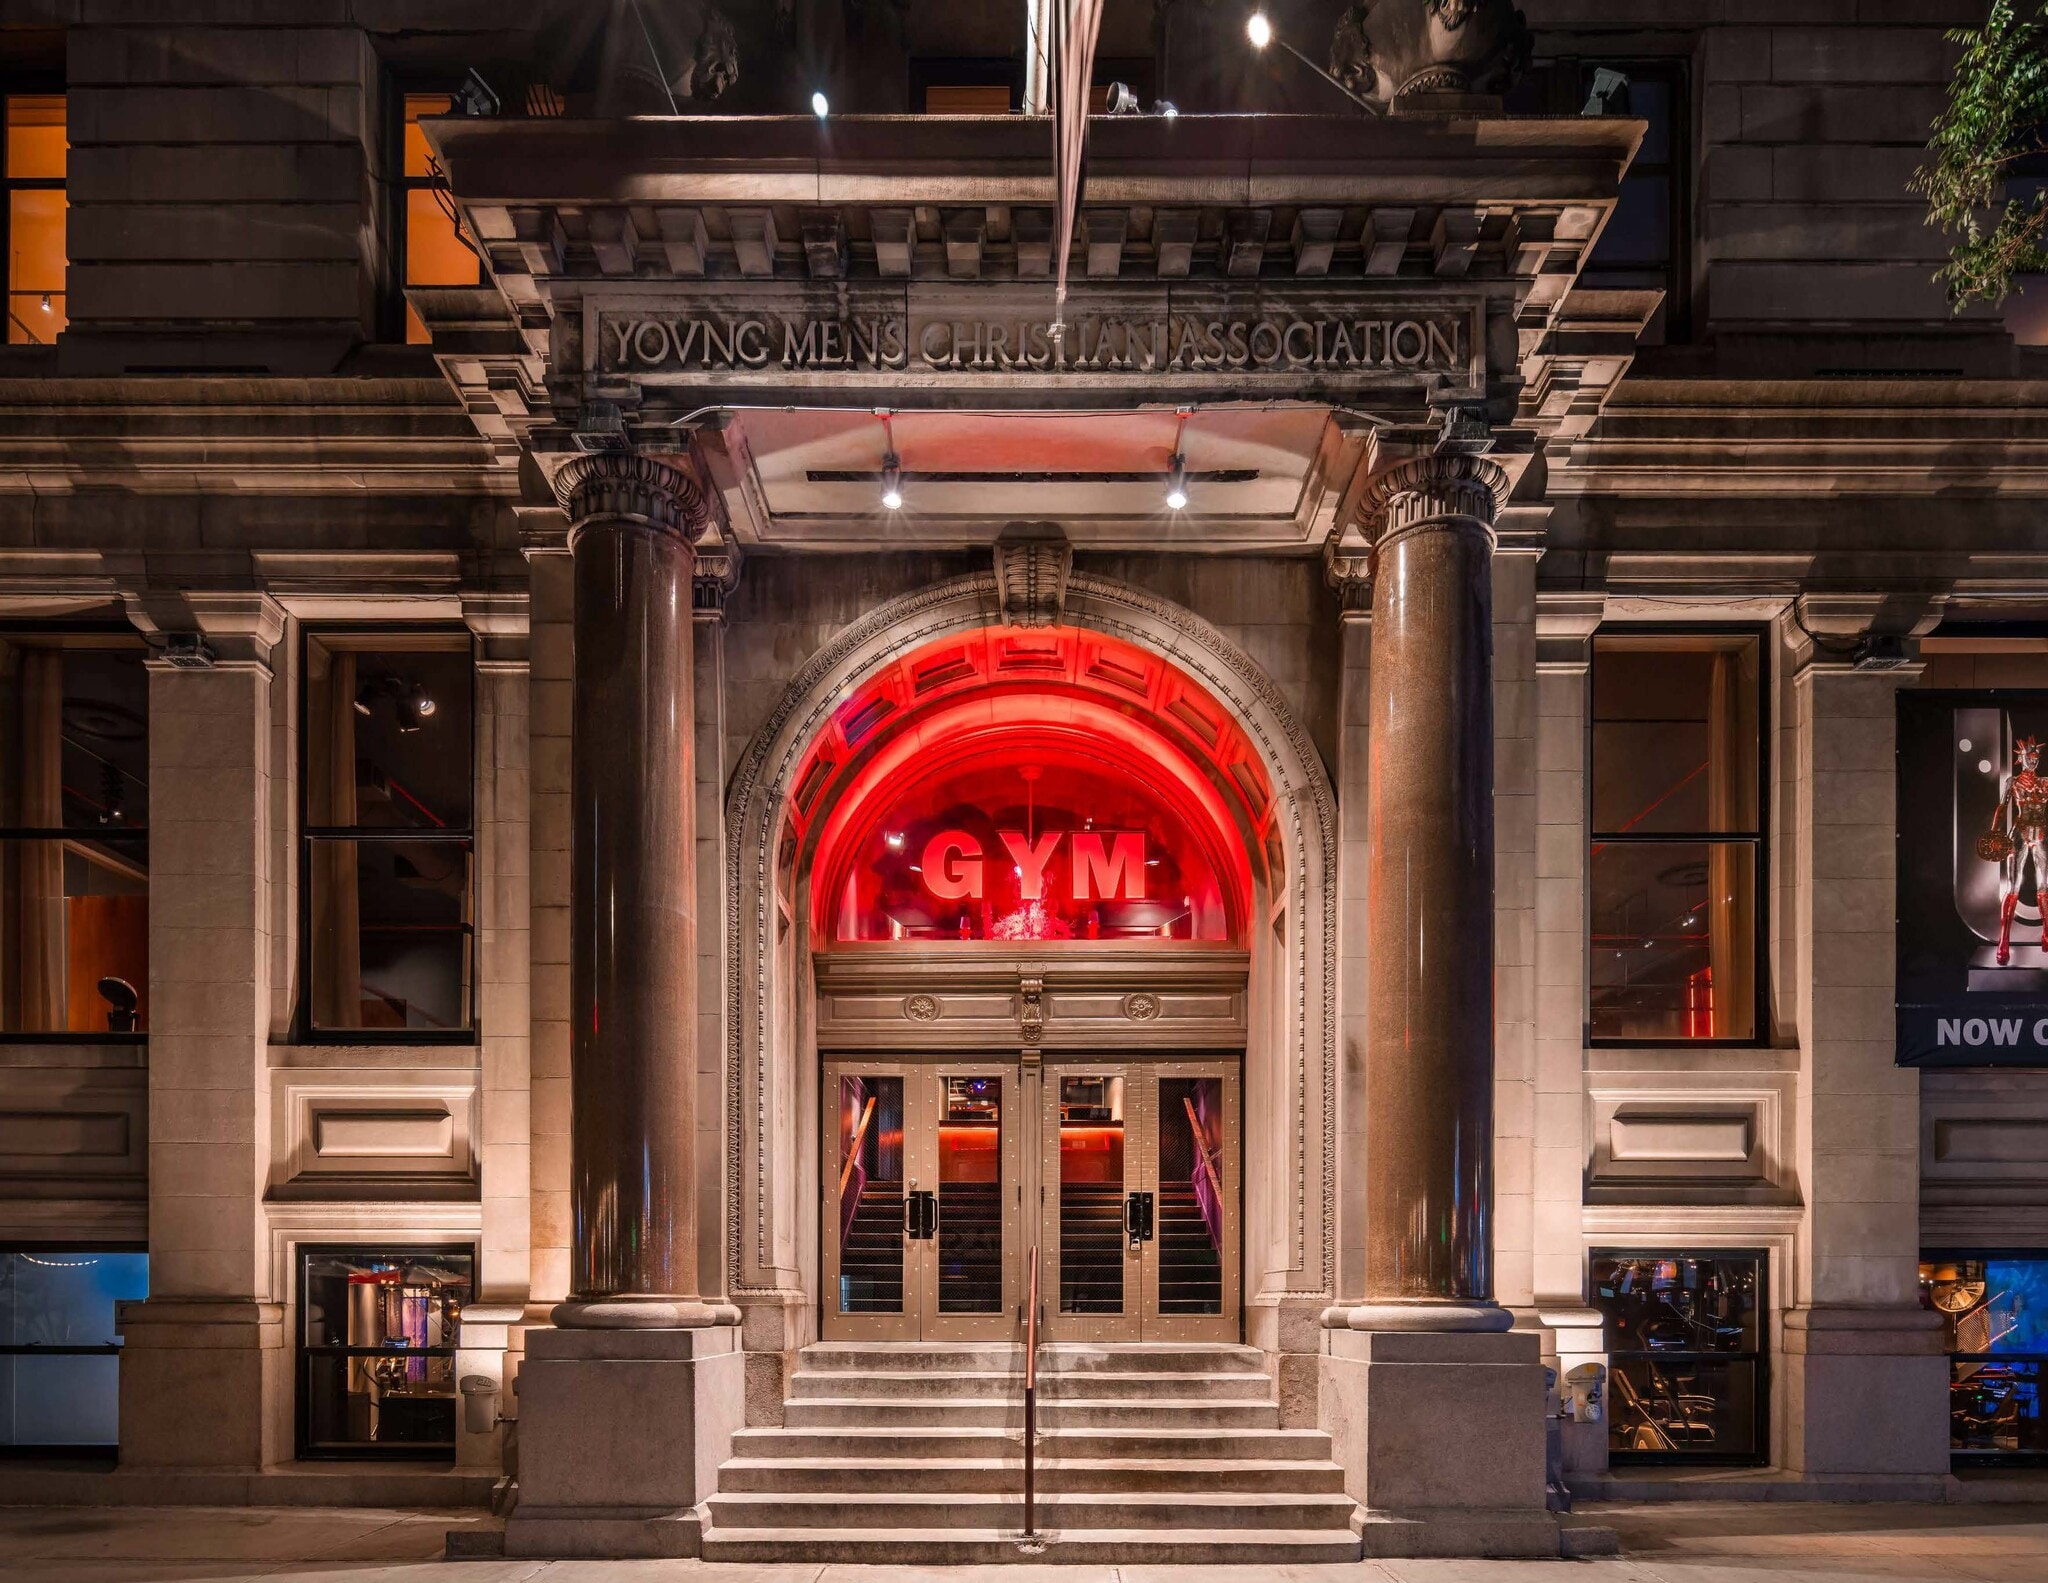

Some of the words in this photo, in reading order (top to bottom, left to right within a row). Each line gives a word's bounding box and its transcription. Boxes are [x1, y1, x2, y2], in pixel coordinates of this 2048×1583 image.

[611, 319, 769, 366] YOVNG
[1169, 319, 1461, 368] ASSOCIATION
[921, 830, 1146, 900] GYM
[1937, 1018, 2024, 1046] NOW
